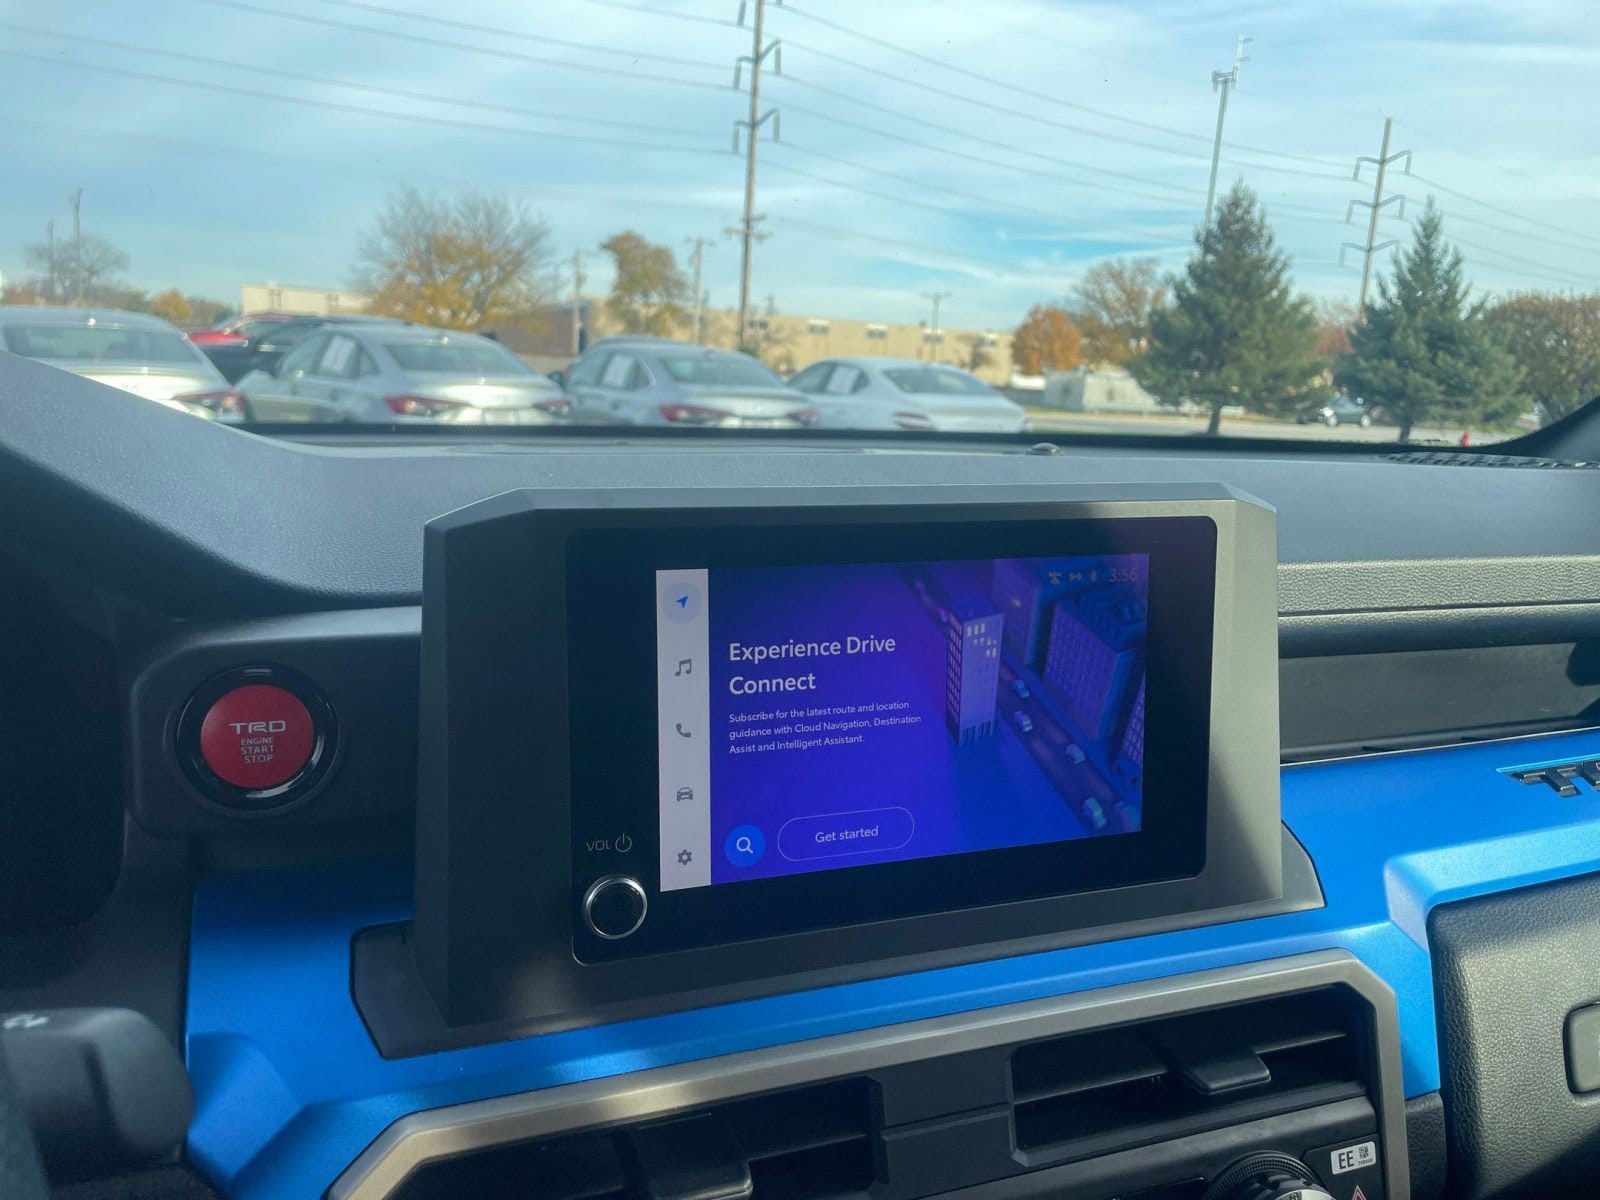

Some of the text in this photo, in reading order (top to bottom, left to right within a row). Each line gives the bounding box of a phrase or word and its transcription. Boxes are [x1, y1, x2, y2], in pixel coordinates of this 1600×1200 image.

[729, 635, 897, 664] Experience Drive
[729, 673, 817, 695] Connect
[729, 701, 910, 723] Subscribe for the latest route and location
[229, 720, 286, 735] TRD
[729, 714, 922, 741] guidance with Cloud Navigation, Destination
[240, 737, 273, 746] ENGINE
[240, 745, 274, 755] START
[729, 734, 865, 754] Assist and Intelligent Assistant.
[244, 753, 274, 764] STOP
[815, 824, 879, 843] Get started
[586, 840, 611, 851] VOL
[1338, 1150, 1354, 1169] EE
